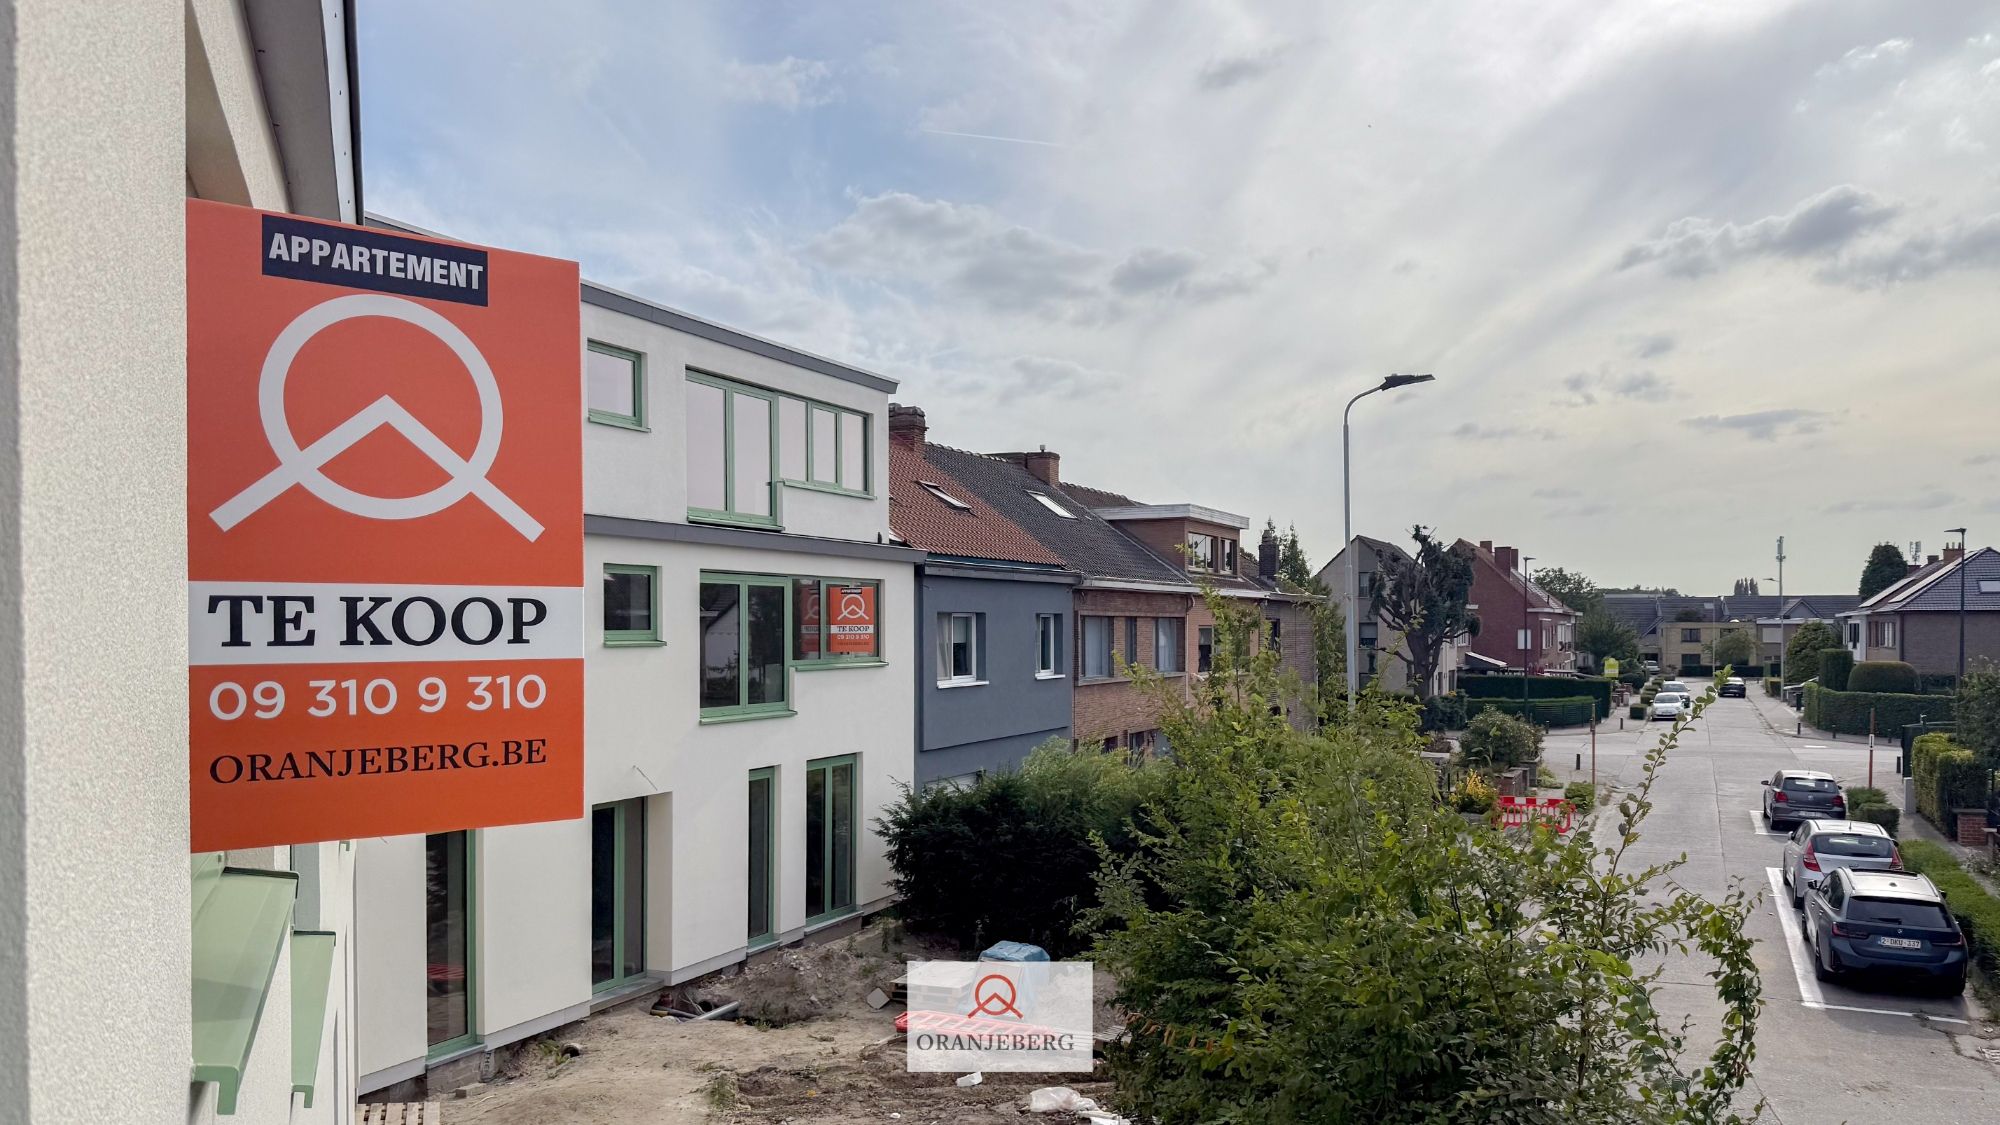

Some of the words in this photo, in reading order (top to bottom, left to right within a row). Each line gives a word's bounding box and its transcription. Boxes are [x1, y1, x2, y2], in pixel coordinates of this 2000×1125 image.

[268, 232, 484, 290] APPARTEMENT
[207, 594, 316, 647] TE
[339, 596, 548, 647] KOOP
[209, 680, 286, 721] 09
[307, 677, 398, 718] 310
[418, 676, 447, 714] 9
[466, 674, 547, 712] 310
[209, 738, 547, 784] ORANJEBERG.BE
